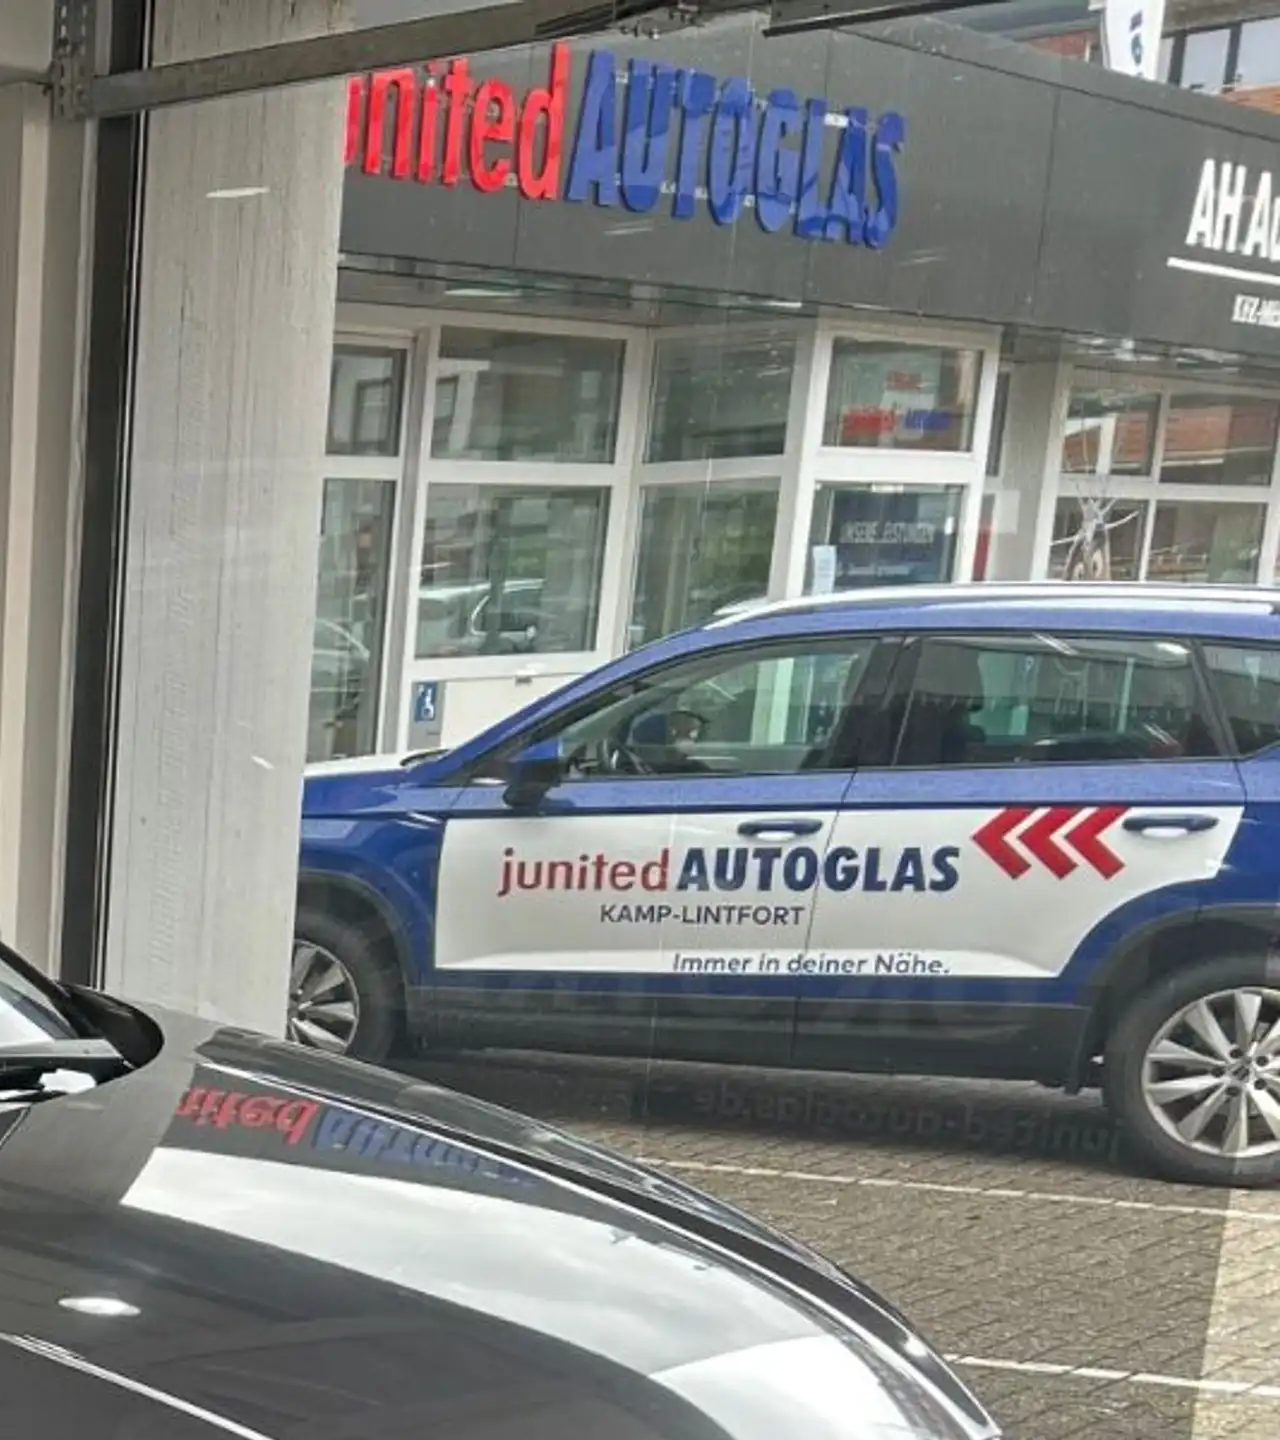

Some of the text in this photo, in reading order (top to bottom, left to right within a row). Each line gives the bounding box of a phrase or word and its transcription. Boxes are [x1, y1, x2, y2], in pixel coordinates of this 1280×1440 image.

[565, 50, 906, 248] AUTOGLAS
[1185, 158, 1247, 254] AH
[497, 846, 960, 897] junited AUTOGLAS
[600, 904, 806, 926] KAMP-LINTFORT
[672, 951, 951, 975] Immer in deiner Nähe.
